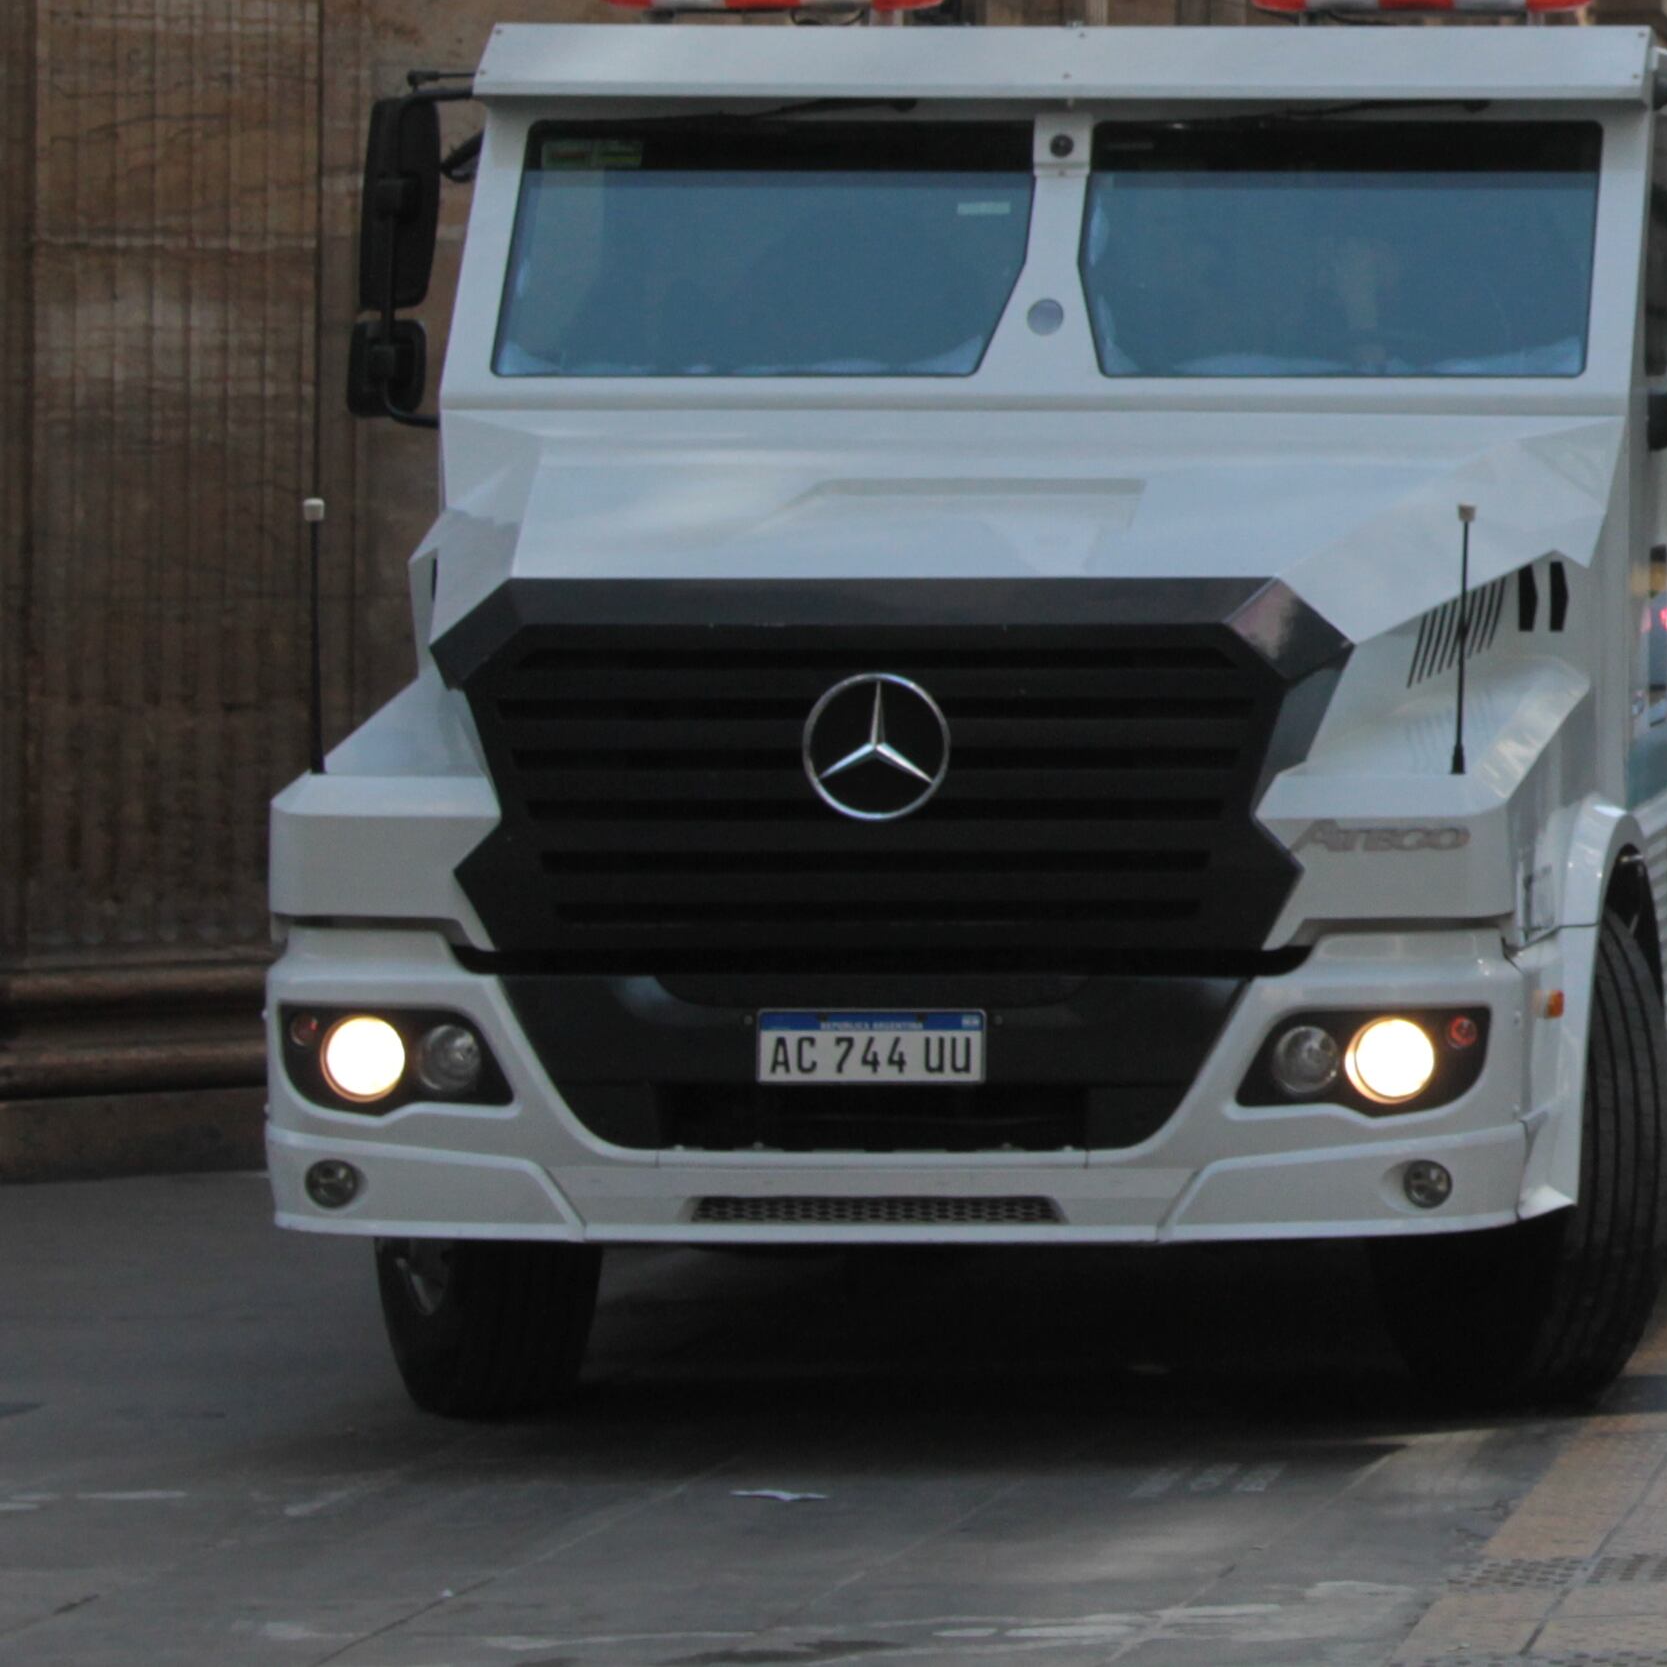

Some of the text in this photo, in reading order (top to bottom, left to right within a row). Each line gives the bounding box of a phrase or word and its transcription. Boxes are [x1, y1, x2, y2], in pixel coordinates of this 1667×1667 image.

[769, 1036, 972, 1075] AC 744 UU
